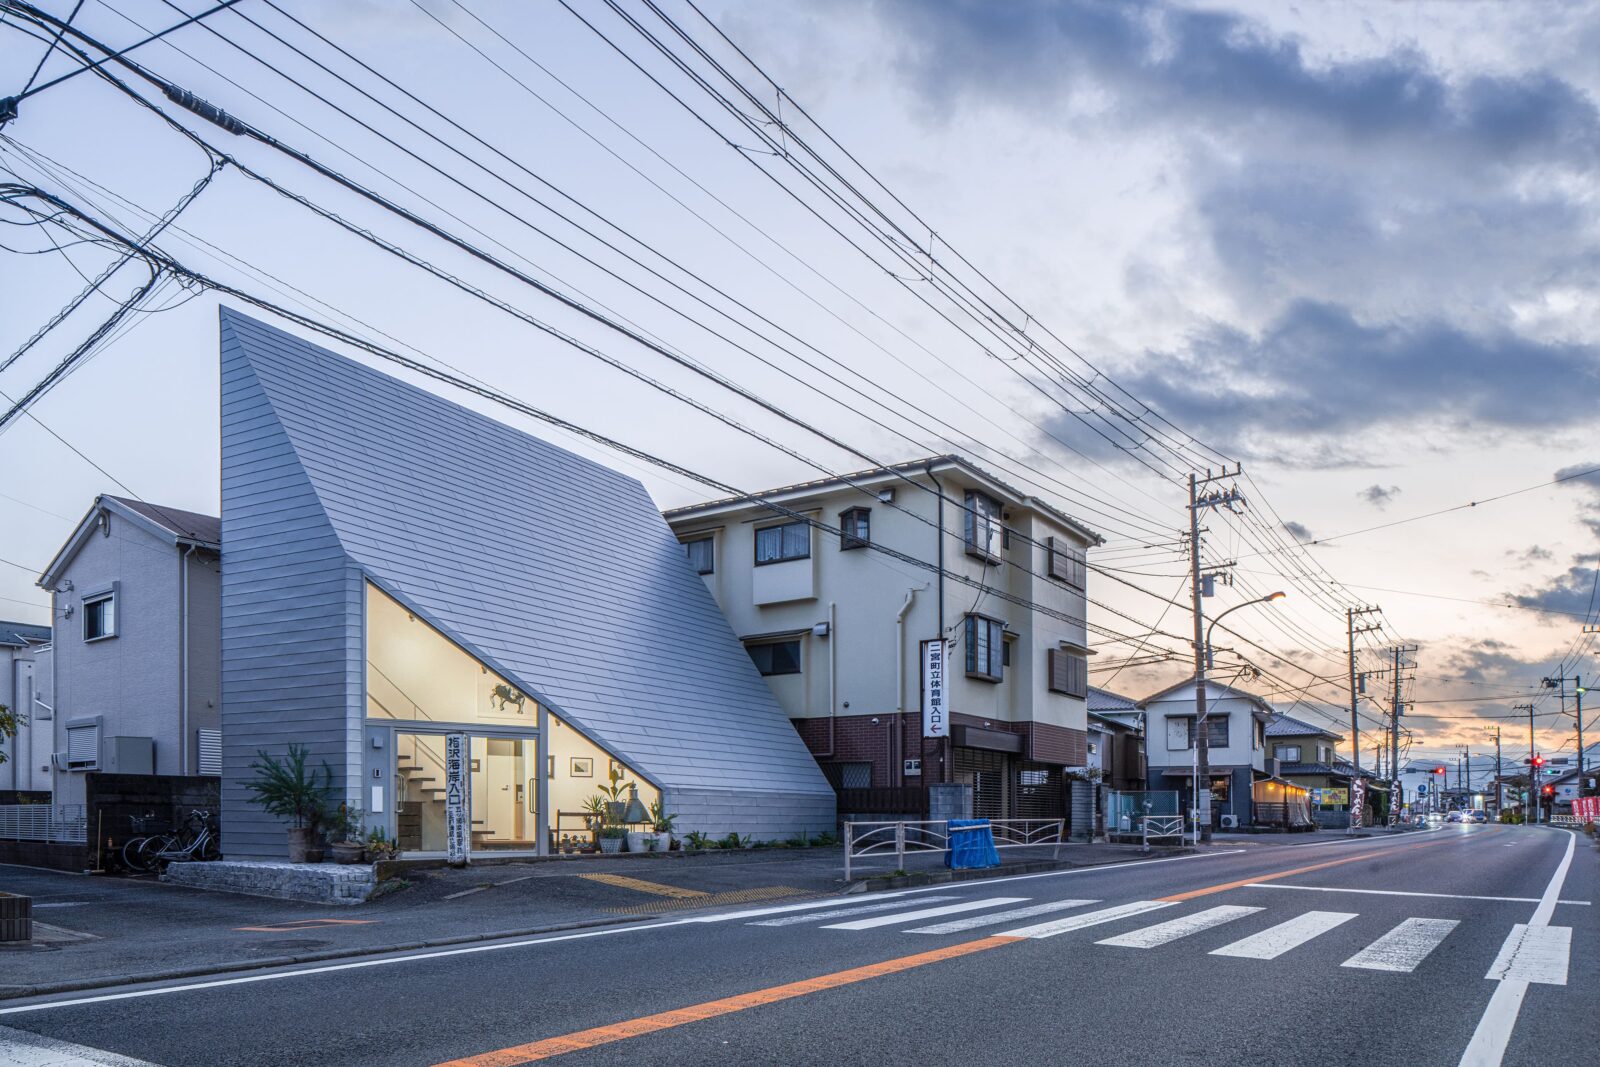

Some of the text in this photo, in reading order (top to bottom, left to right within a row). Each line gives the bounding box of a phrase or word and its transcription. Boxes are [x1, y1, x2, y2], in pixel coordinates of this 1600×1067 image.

[930, 643, 942, 723] 二宮町立体育館入口
